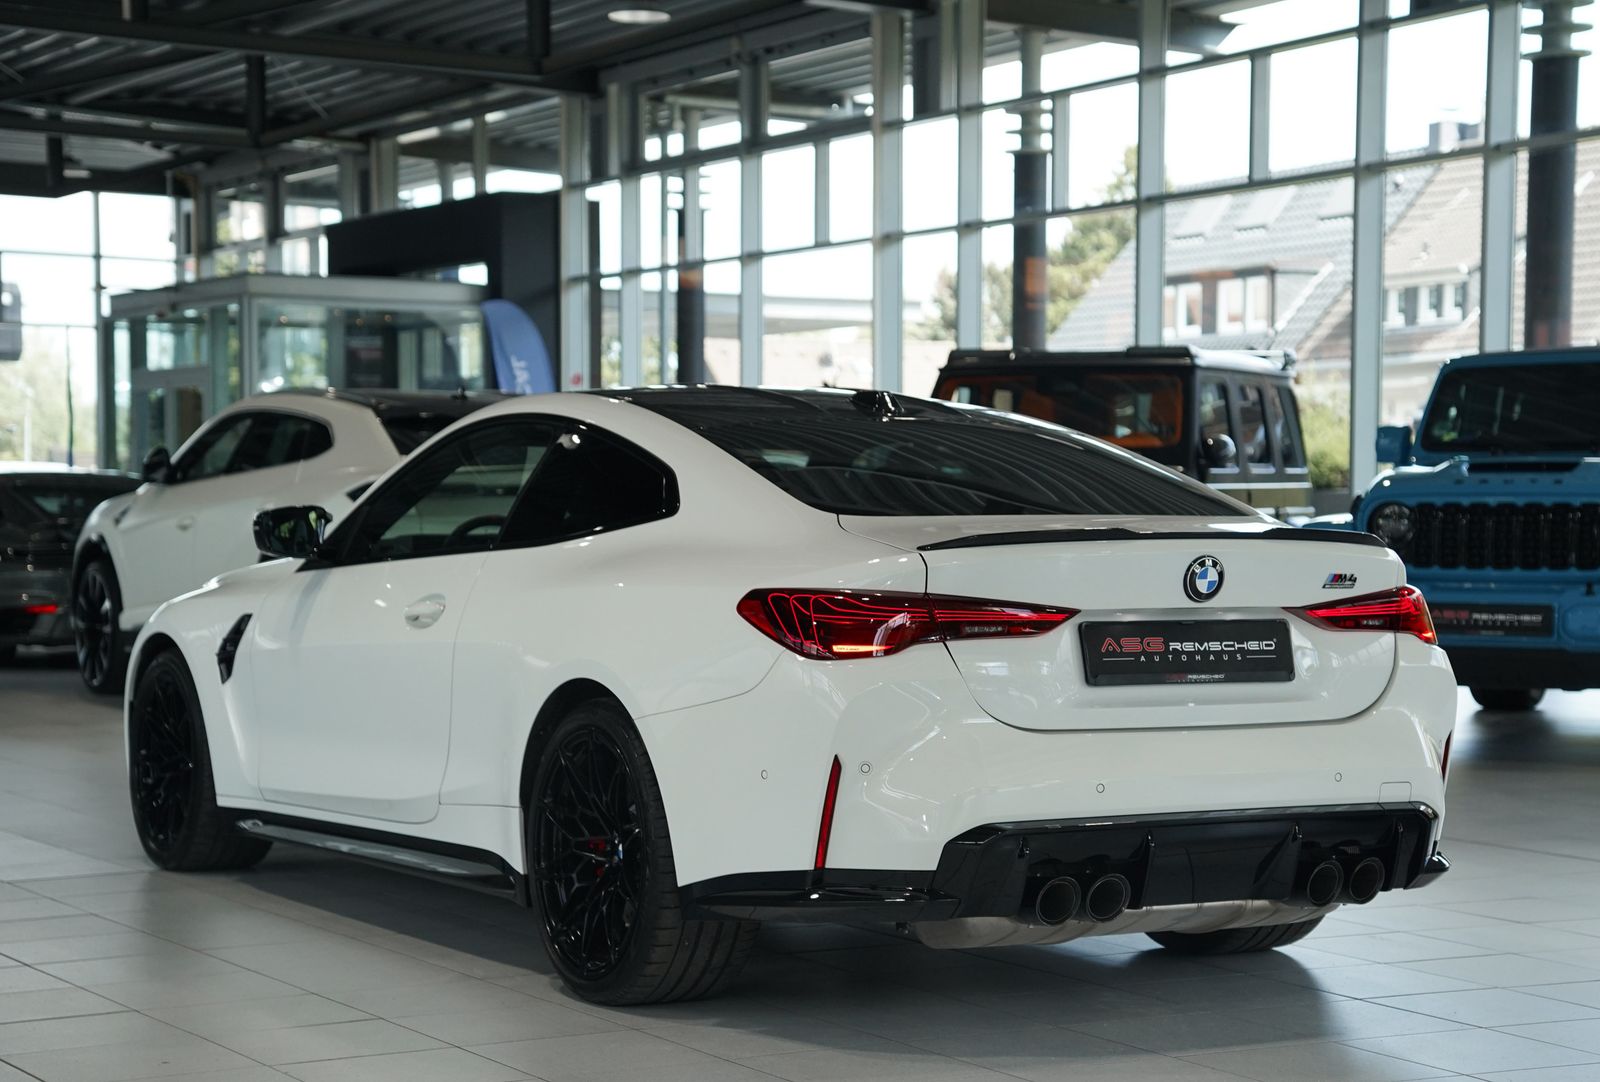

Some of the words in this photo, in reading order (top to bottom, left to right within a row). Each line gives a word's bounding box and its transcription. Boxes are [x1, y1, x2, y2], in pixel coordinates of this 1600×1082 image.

[1194, 559, 1222, 573] BMW
[1335, 573, 1358, 584] M4
[1101, 637, 1166, 653] ASG
[1140, 653, 1242, 662] AUTOHAUS
